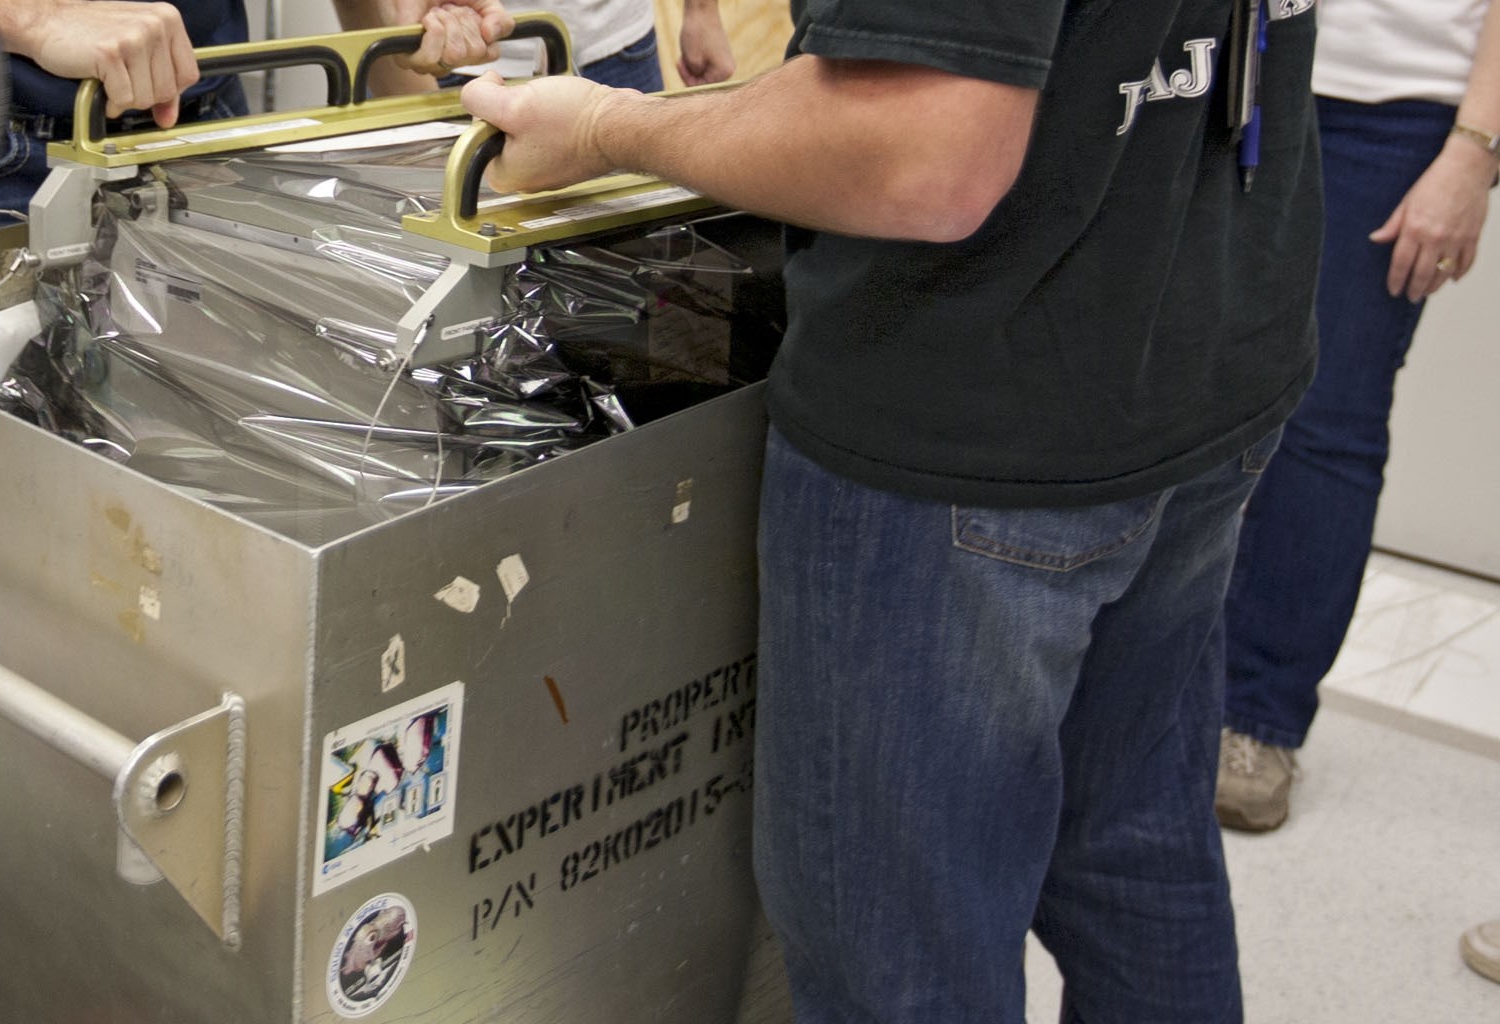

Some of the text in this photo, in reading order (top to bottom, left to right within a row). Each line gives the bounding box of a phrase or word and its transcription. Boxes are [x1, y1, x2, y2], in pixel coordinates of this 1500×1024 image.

[619, 653, 756, 752] PROPERT
[468, 732, 688, 873] EXPERIMENT
[710, 699, 756, 754] INT
[472, 872, 536, 940] P/N
